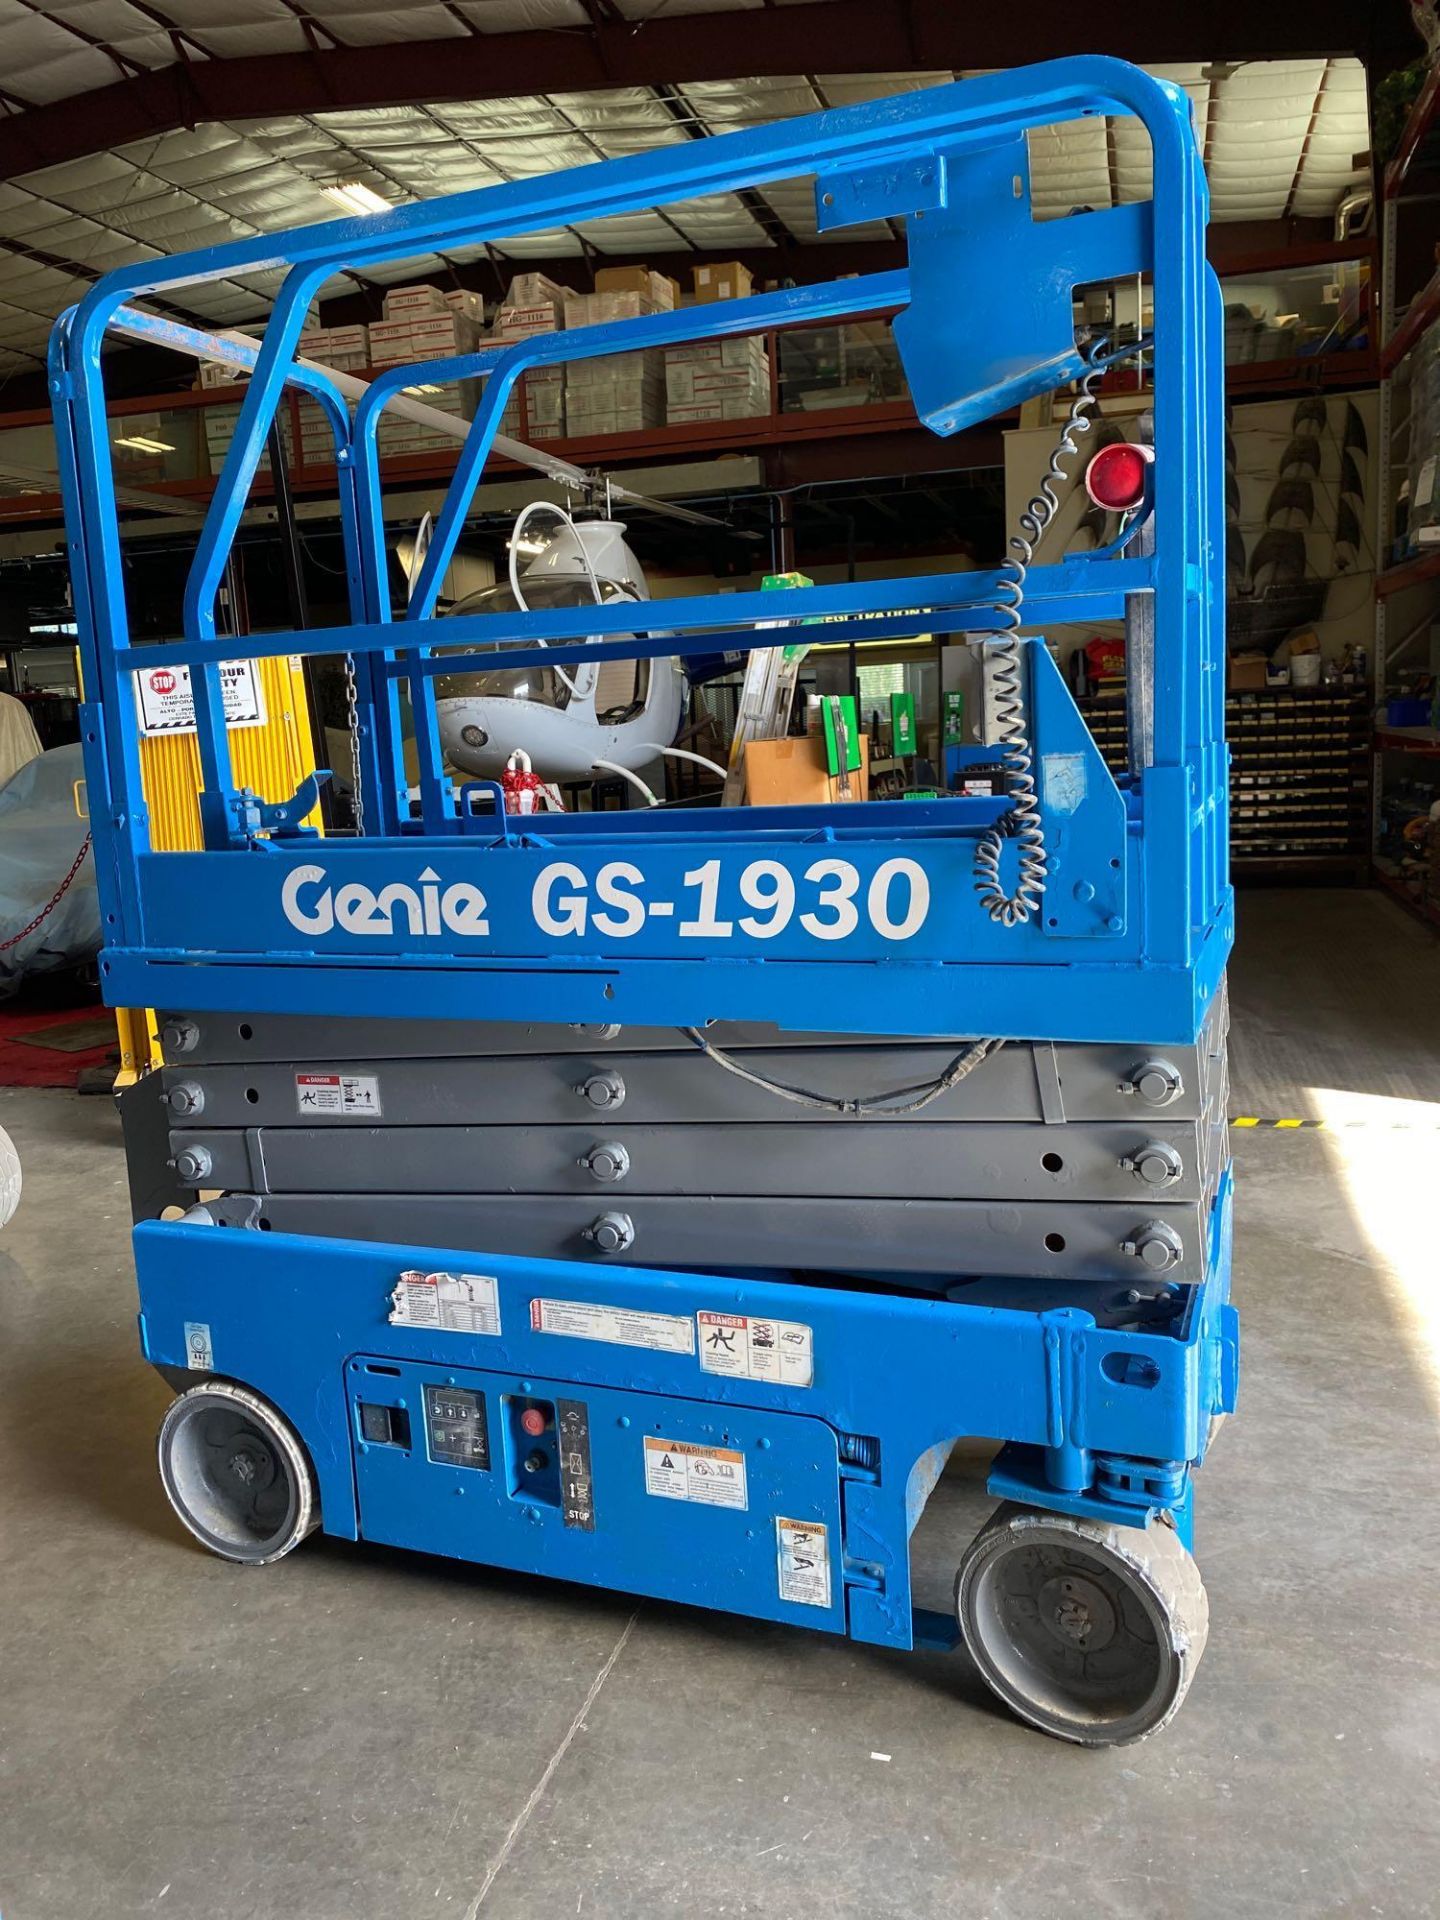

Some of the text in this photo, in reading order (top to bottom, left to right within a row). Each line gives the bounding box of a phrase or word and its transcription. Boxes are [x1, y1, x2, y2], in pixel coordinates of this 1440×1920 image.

[220, 668, 245, 677] OUR
[153, 676, 174, 689] STOP
[161, 699, 195, 707] TEMPORA
[281, 858, 930, 940] Genie GS-1930
[710, 1316, 743, 1327] DANGER
[680, 1444, 718, 1458] WARNING
[568, 1509, 590, 1521] STOP
[789, 1521, 822, 1534] WARNING
